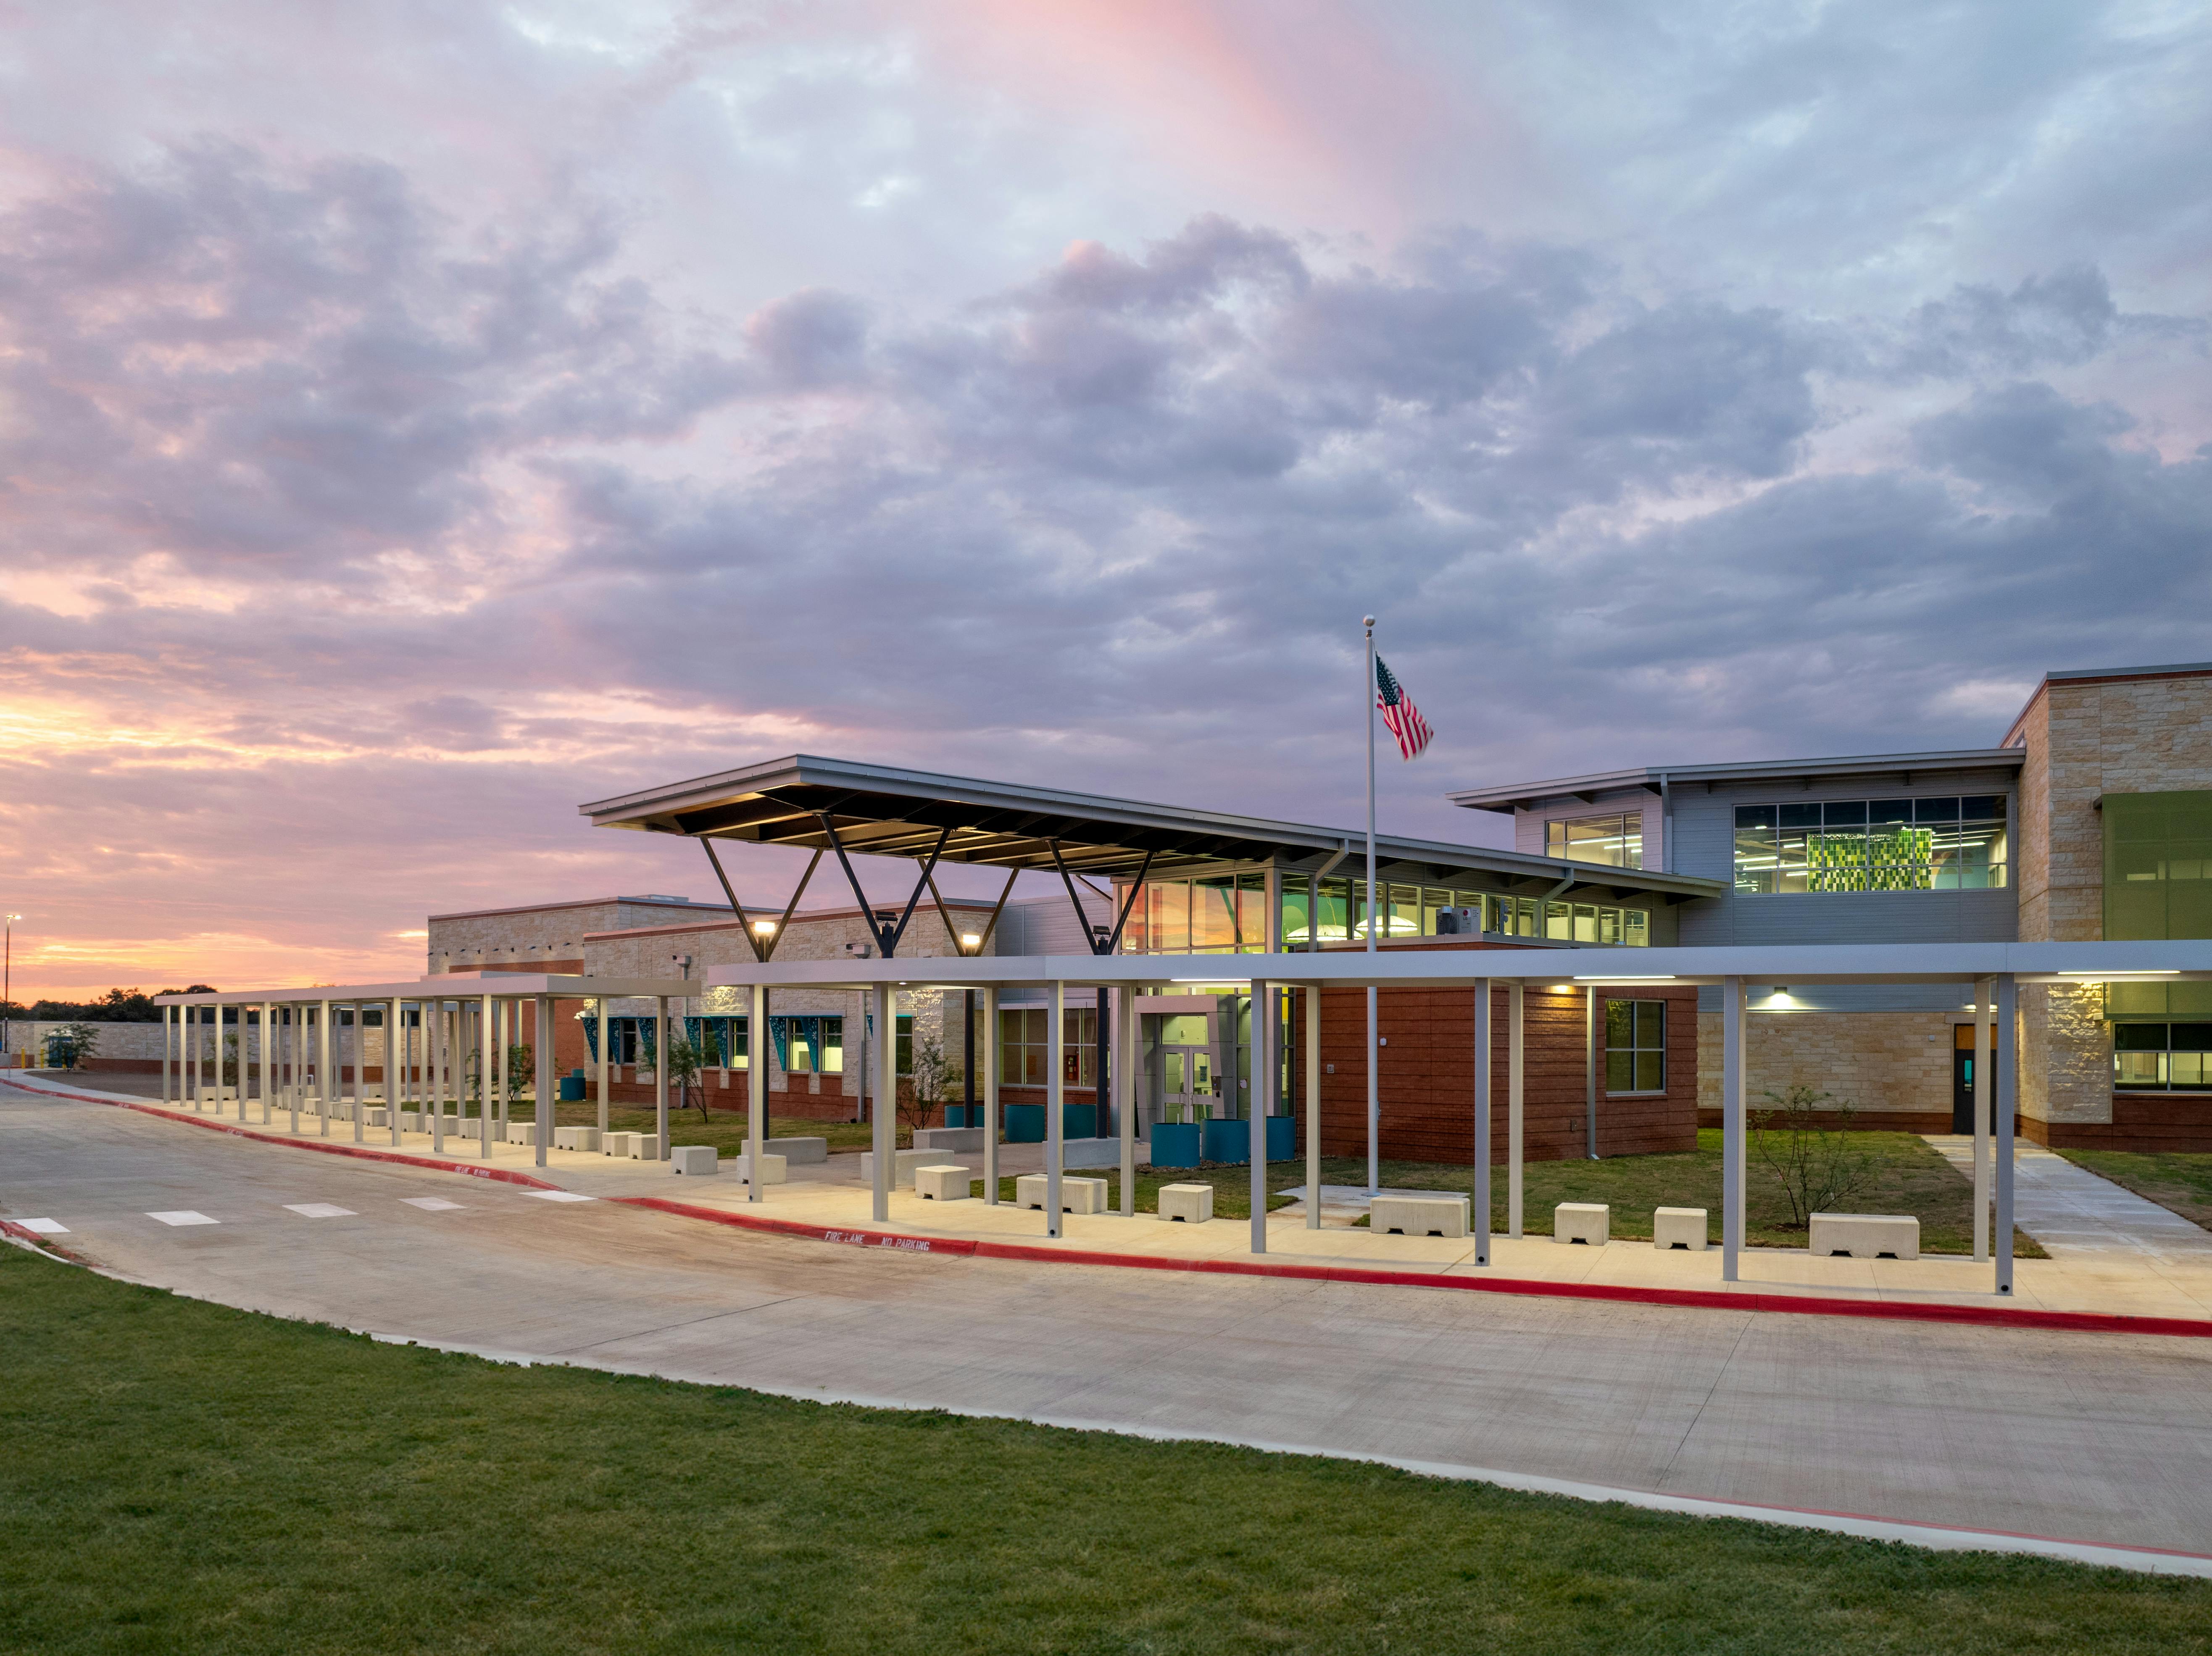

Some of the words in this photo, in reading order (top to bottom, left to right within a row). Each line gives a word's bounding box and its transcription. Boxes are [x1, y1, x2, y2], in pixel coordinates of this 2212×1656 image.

[825, 1231, 842, 1241] FIRE
[844, 1233, 865, 1243] LANE
[881, 1237, 892, 1246] NO
[895, 1238, 930, 1251] PARKING
